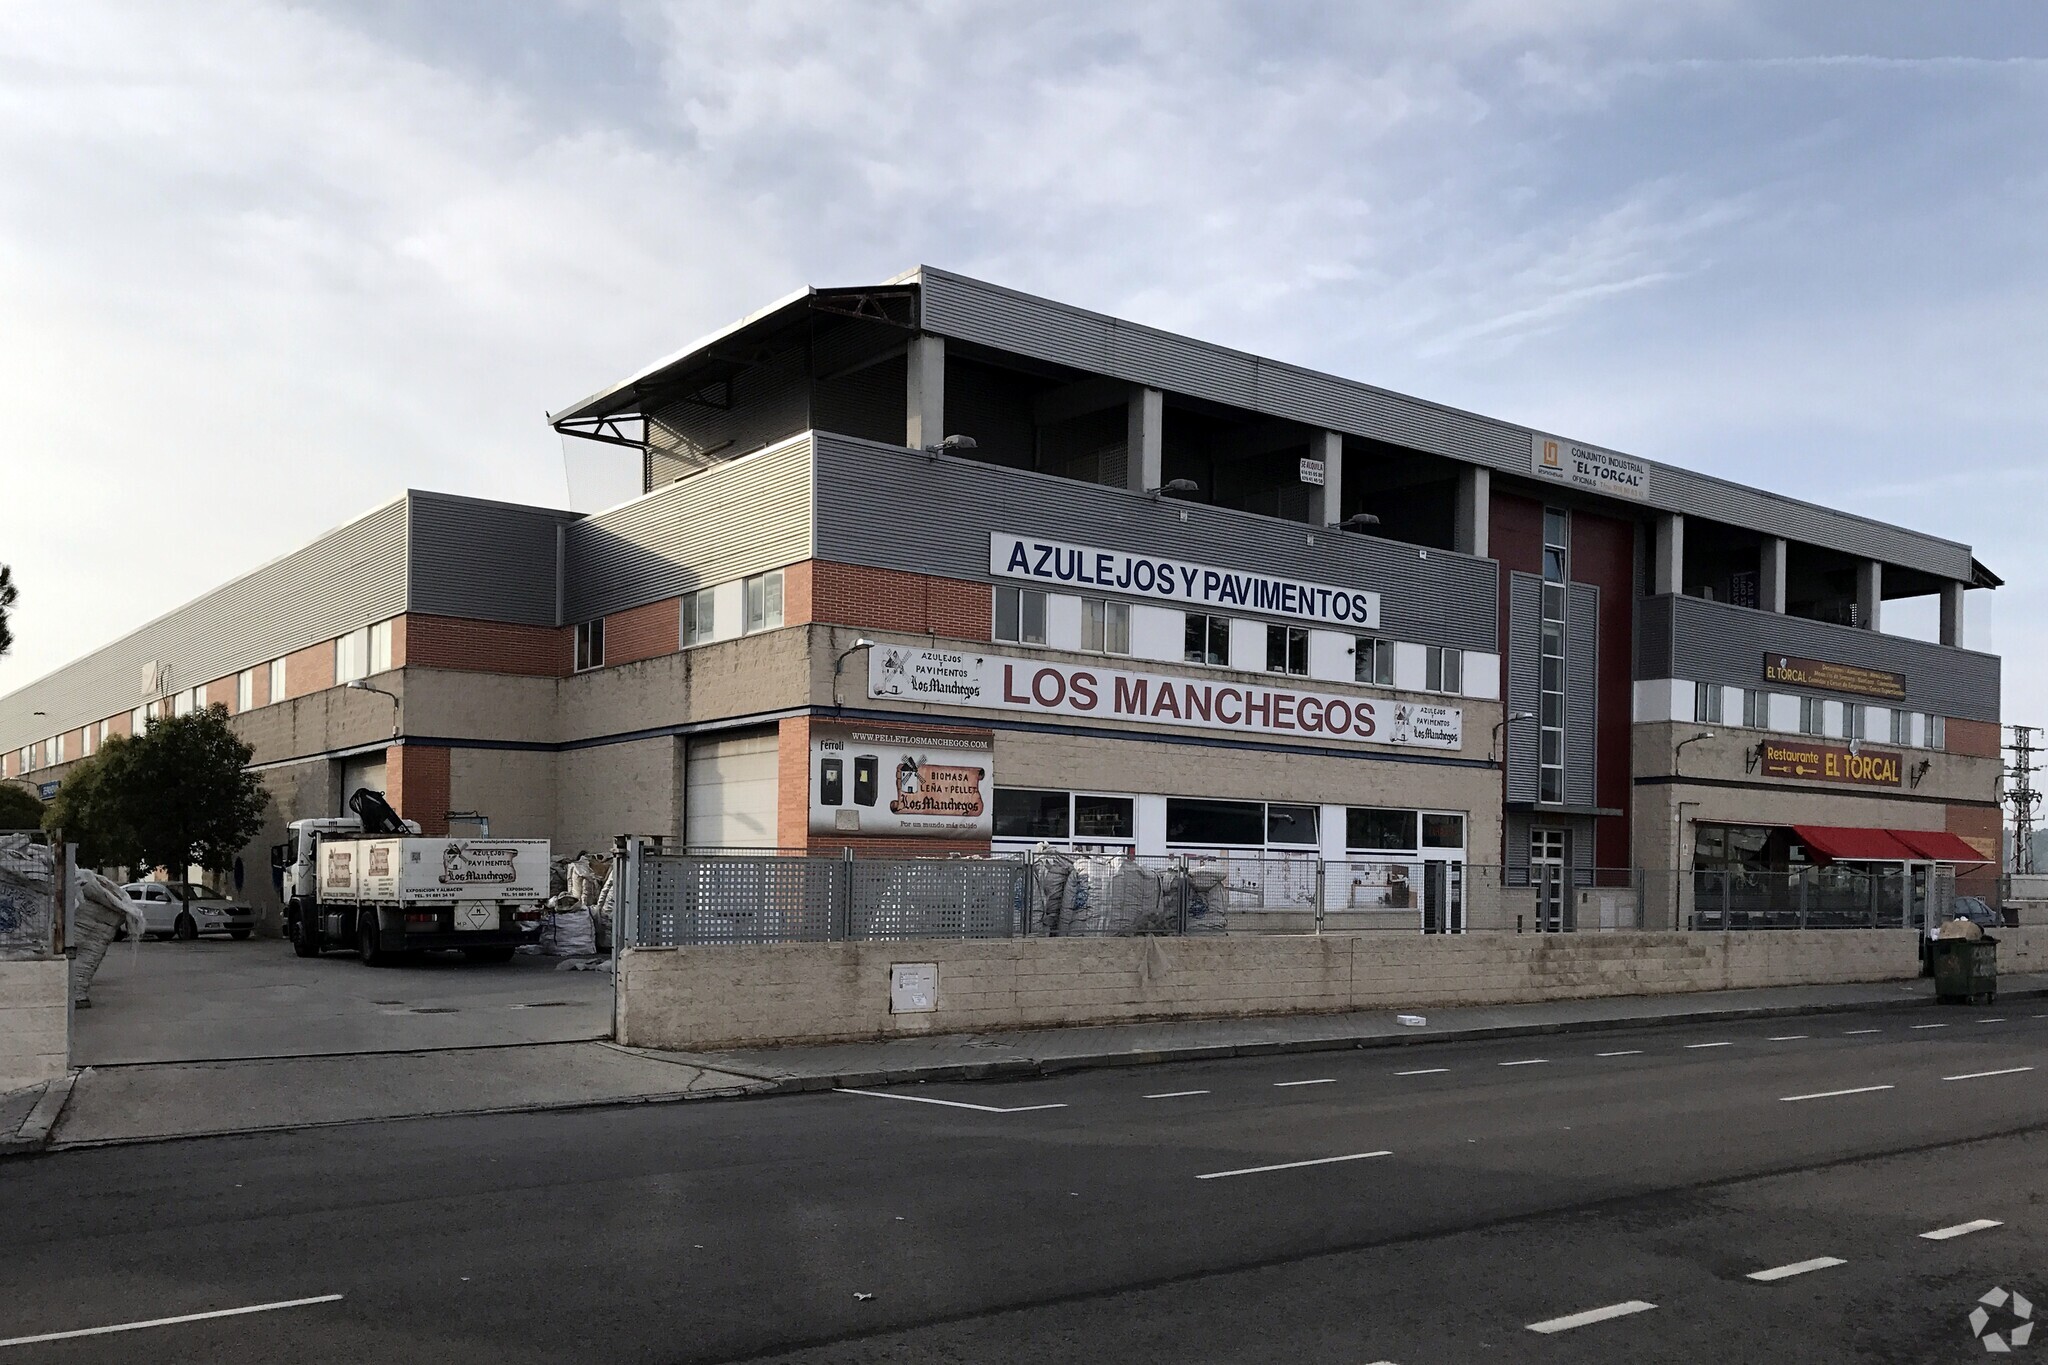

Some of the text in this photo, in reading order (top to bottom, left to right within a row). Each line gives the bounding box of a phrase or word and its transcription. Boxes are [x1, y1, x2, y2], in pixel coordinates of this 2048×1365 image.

[1571, 447, 1644, 474] CONJUNTO INDUSTRIAL
[1572, 475, 1597, 487] OFICINAS
[1007, 541, 1368, 624] AZULEJOS Y PAVIMENTOS
[921, 652, 962, 663] AZULEJOS
[916, 665, 968, 678] PAVIMENTOS
[1767, 666, 1776, 678] EL
[1777, 668, 1807, 683] TORCAL
[911, 674, 982, 700] Los Manchegos
[1003, 664, 1377, 738] LOS MANCHEGOS
[1420, 707, 1446, 716] AZULEJOS
[1416, 718, 1450, 727] PAVIMENTOS
[852, 732, 988, 749] WWW.PELLETLOSMANCHEGOS.COM
[1414, 726, 1458, 745] Los Manchegos
[820, 740, 844, 751] Ferroli
[1767, 746, 1899, 782] Restaurante EL TORCAL
[931, 772, 969, 782] BIOMASA
[920, 782, 942, 793] LEÑA
[900, 794, 979, 815] Los Manchegos
[900, 820, 911, 828] Por
[448, 870, 513, 883] Los Manchegos
